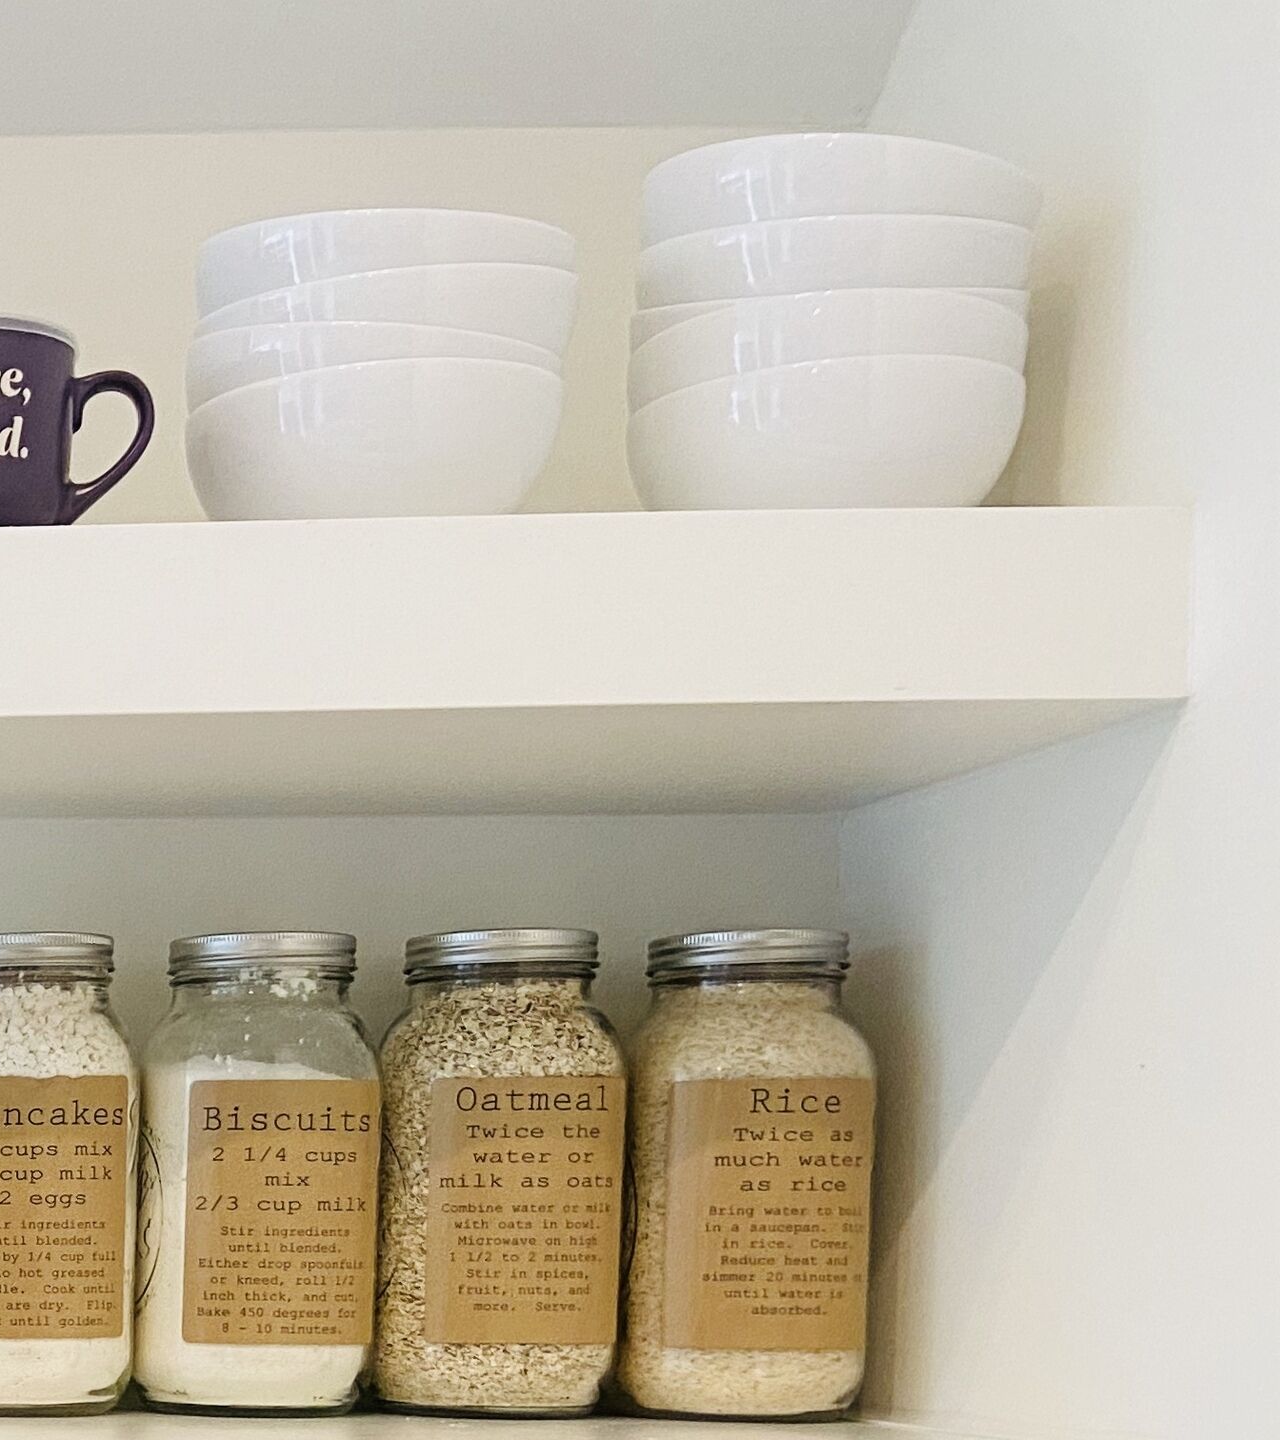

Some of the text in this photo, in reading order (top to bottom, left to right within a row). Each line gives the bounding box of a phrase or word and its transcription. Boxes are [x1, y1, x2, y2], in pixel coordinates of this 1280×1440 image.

[457, 1086, 608, 1111] Oatmeal
[750, 1088, 840, 1113] Rice
[203, 1106, 370, 1131] Biscuits
[467, 1124, 600, 1138] Twice the
[734, 1127, 853, 1141] Twice as
[0, 1144, 58, 1159] cups
[74, 1141, 112, 1156] mix
[212, 1146, 357, 1165] 2 1/4 cups
[474, 1150, 594, 1163] water or
[714, 1152, 863, 1166] much water
[0, 1169, 43, 1184] cup
[60, 1166, 112, 1180] milk
[265, 1172, 310, 1186] mix
[440, 1174, 612, 1188] milk as oats
[740, 1177, 847, 1191] as rice
[0, 1191, 86, 1208] 2 eggs
[195, 1195, 366, 1214] 2/3 cup milk
[442, 1203, 502, 1213] Combine
[512, 1204, 553, 1213] water
[563, 1205, 578, 1213] or
[709, 1206, 831, 1217] Bring water to
[21, 1220, 106, 1232] ingredients
[455, 1220, 600, 1229] with oats in bowl.
[705, 1223, 721, 1232] in
[750, 1224, 826, 1234] saucepan.
[221, 1226, 350, 1238] Stir ingredients
[36, 1237, 97, 1245] blended.
[458, 1236, 535, 1245] Microwave
[570, 1237, 597, 1246] high
[722, 1239, 791, 1249] in rice.
[229, 1243, 341, 1253] until blended.
[3, 1252, 19, 1264] by
[28, 1252, 51, 1261] 1/4
[60, 1254, 84, 1264] cup
[92, 1252, 115, 1261] full
[468, 1252, 491, 1262] 1/2
[503, 1253, 519, 1262] to
[528, 1253, 535, 1262] 2
[544, 1253, 602, 1262] minutes.
[721, 1256, 848, 1265] Reduce heat and
[198, 1259, 248, 1268] Either
[258, 1259, 291, 1270] drop
[19, 1268, 42, 1278] hot
[52, 1268, 104, 1280] greased
[467, 1269, 501, 1278] Stir
[511, 1269, 526, 1278] in
[702, 1272, 755, 1281] simmer
[766, 1272, 783, 1281] 20
[792, 1273, 847, 1281] minutes
[237, 1276, 284, 1286] kneed,
[296, 1276, 326, 1285] roll
[335, 1276, 354, 1285] 1/2
[44, 1285, 74, 1293] Cook
[83, 1284, 115, 1293] until
[459, 1285, 590, 1296] fruit, nuts, and
[724, 1289, 768, 1298] until
[779, 1290, 821, 1298] water
[203, 1292, 326, 1302] inch thick, and
[40, 1301, 69, 1312] dry.
[87, 1301, 117, 1311] Flip.
[473, 1302, 581, 1311] more. Serve.
[751, 1305, 826, 1315] absorbed.
[197, 1307, 356, 1319] Bake 450 degrees for
[10, 1317, 49, 1326] until
[59, 1317, 108, 1328] golden.
[222, 1323, 342, 1334] 8 10 minutes.
